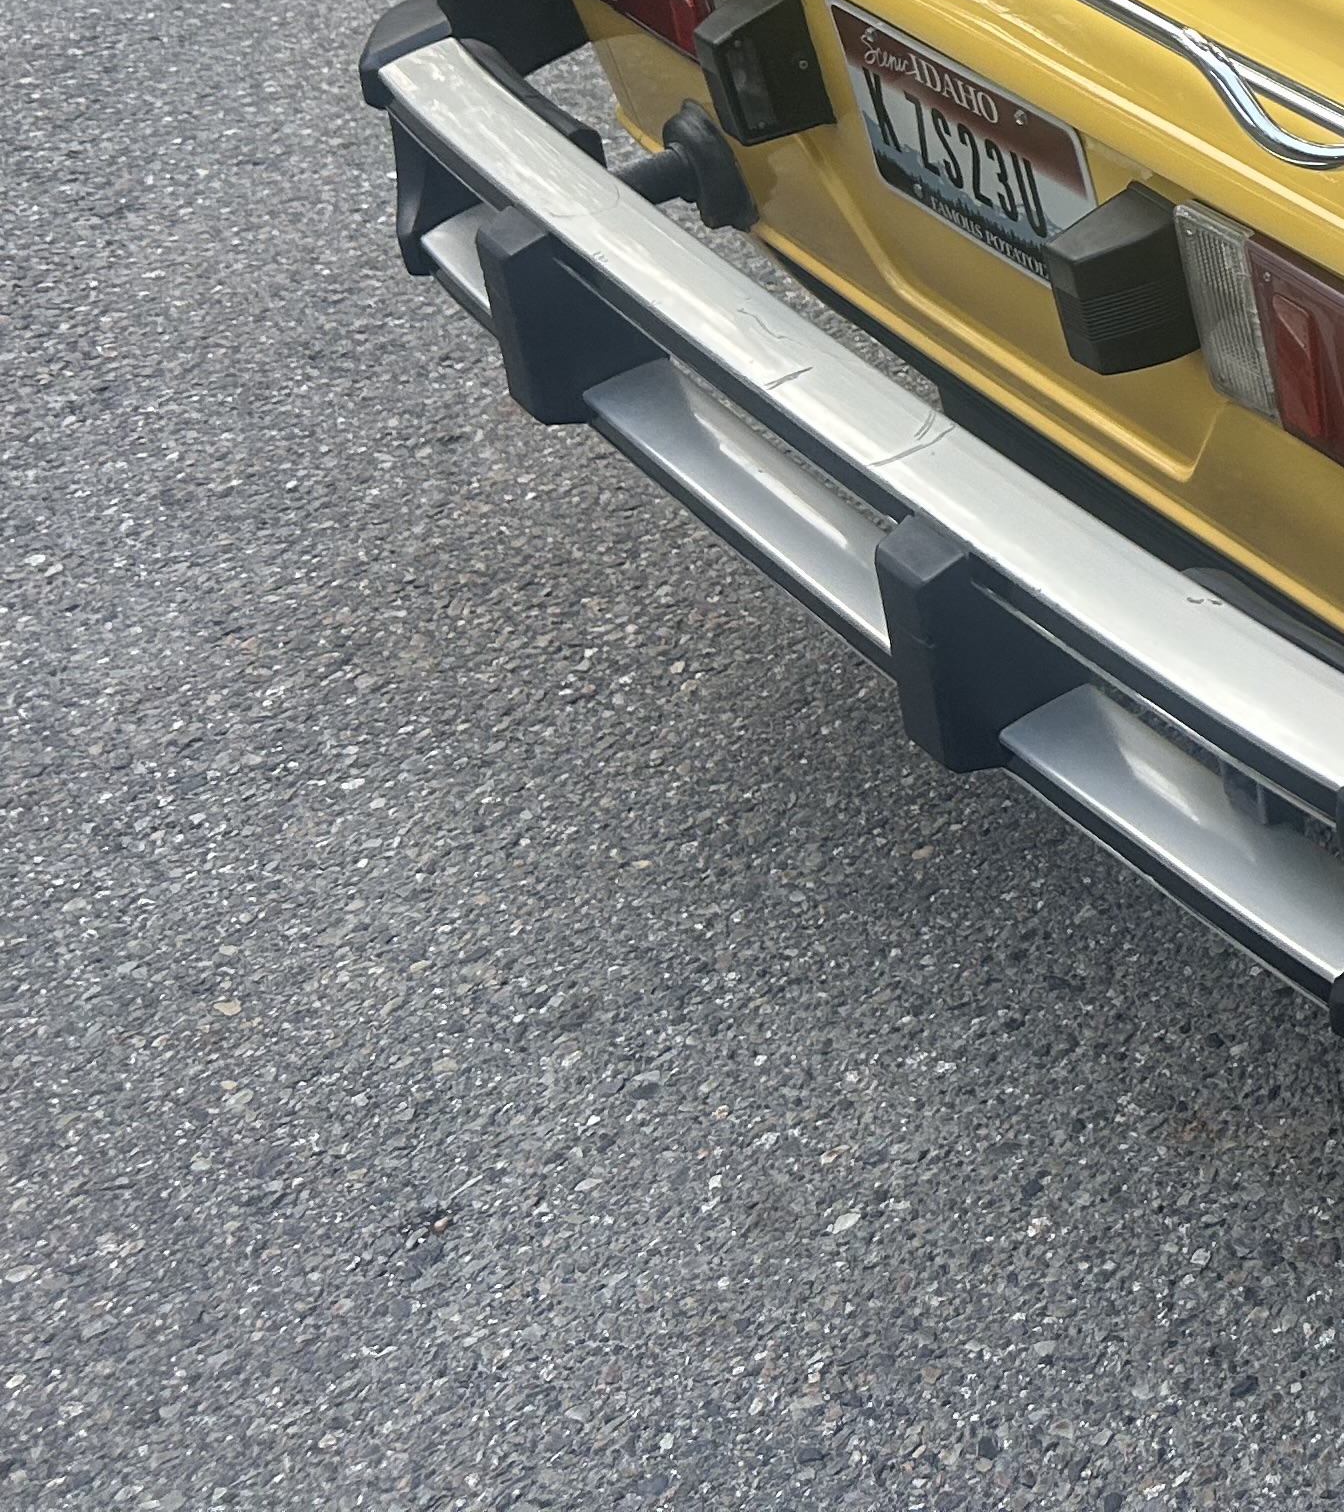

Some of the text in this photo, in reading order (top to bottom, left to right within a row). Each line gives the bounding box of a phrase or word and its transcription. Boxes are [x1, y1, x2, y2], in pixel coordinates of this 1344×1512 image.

[861, 30, 998, 124] Scenic IDAHO
[862, 66, 903, 153] K
[930, 196, 1050, 279] FAMOUS POTATOE
